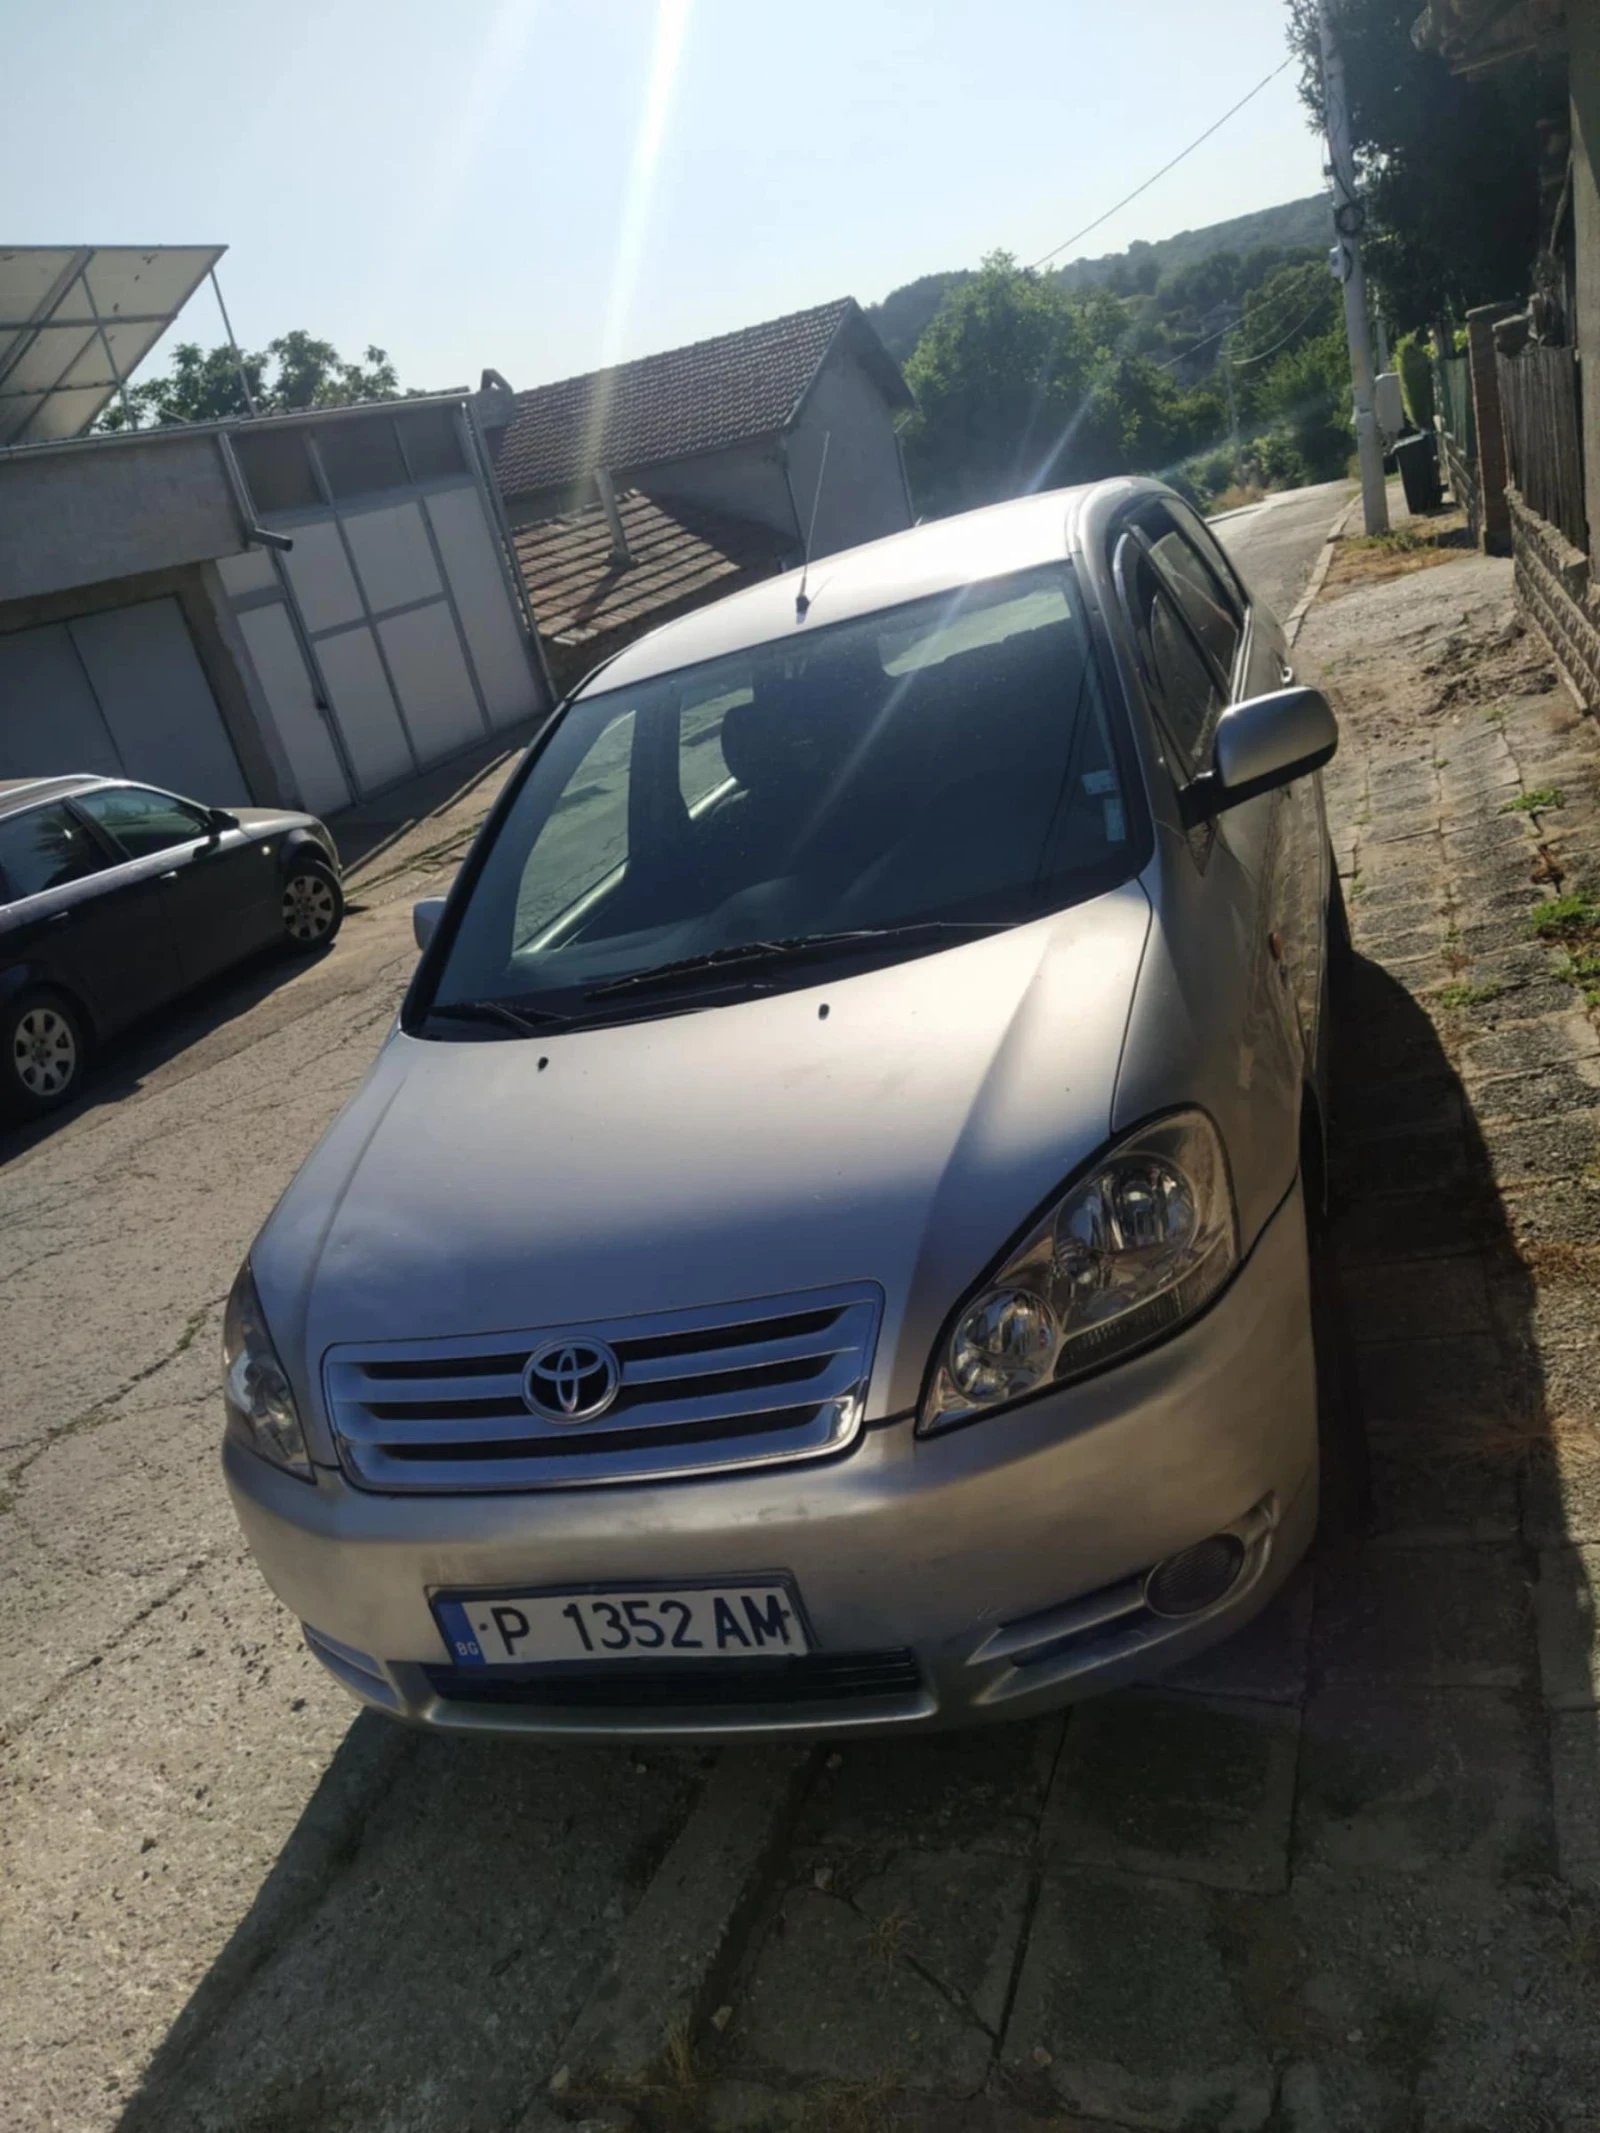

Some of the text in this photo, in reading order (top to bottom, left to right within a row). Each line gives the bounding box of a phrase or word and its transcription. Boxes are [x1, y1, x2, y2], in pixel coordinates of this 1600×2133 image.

[490, 1594, 791, 1655] P 1352 AM
[456, 1641, 480, 1656] BG
